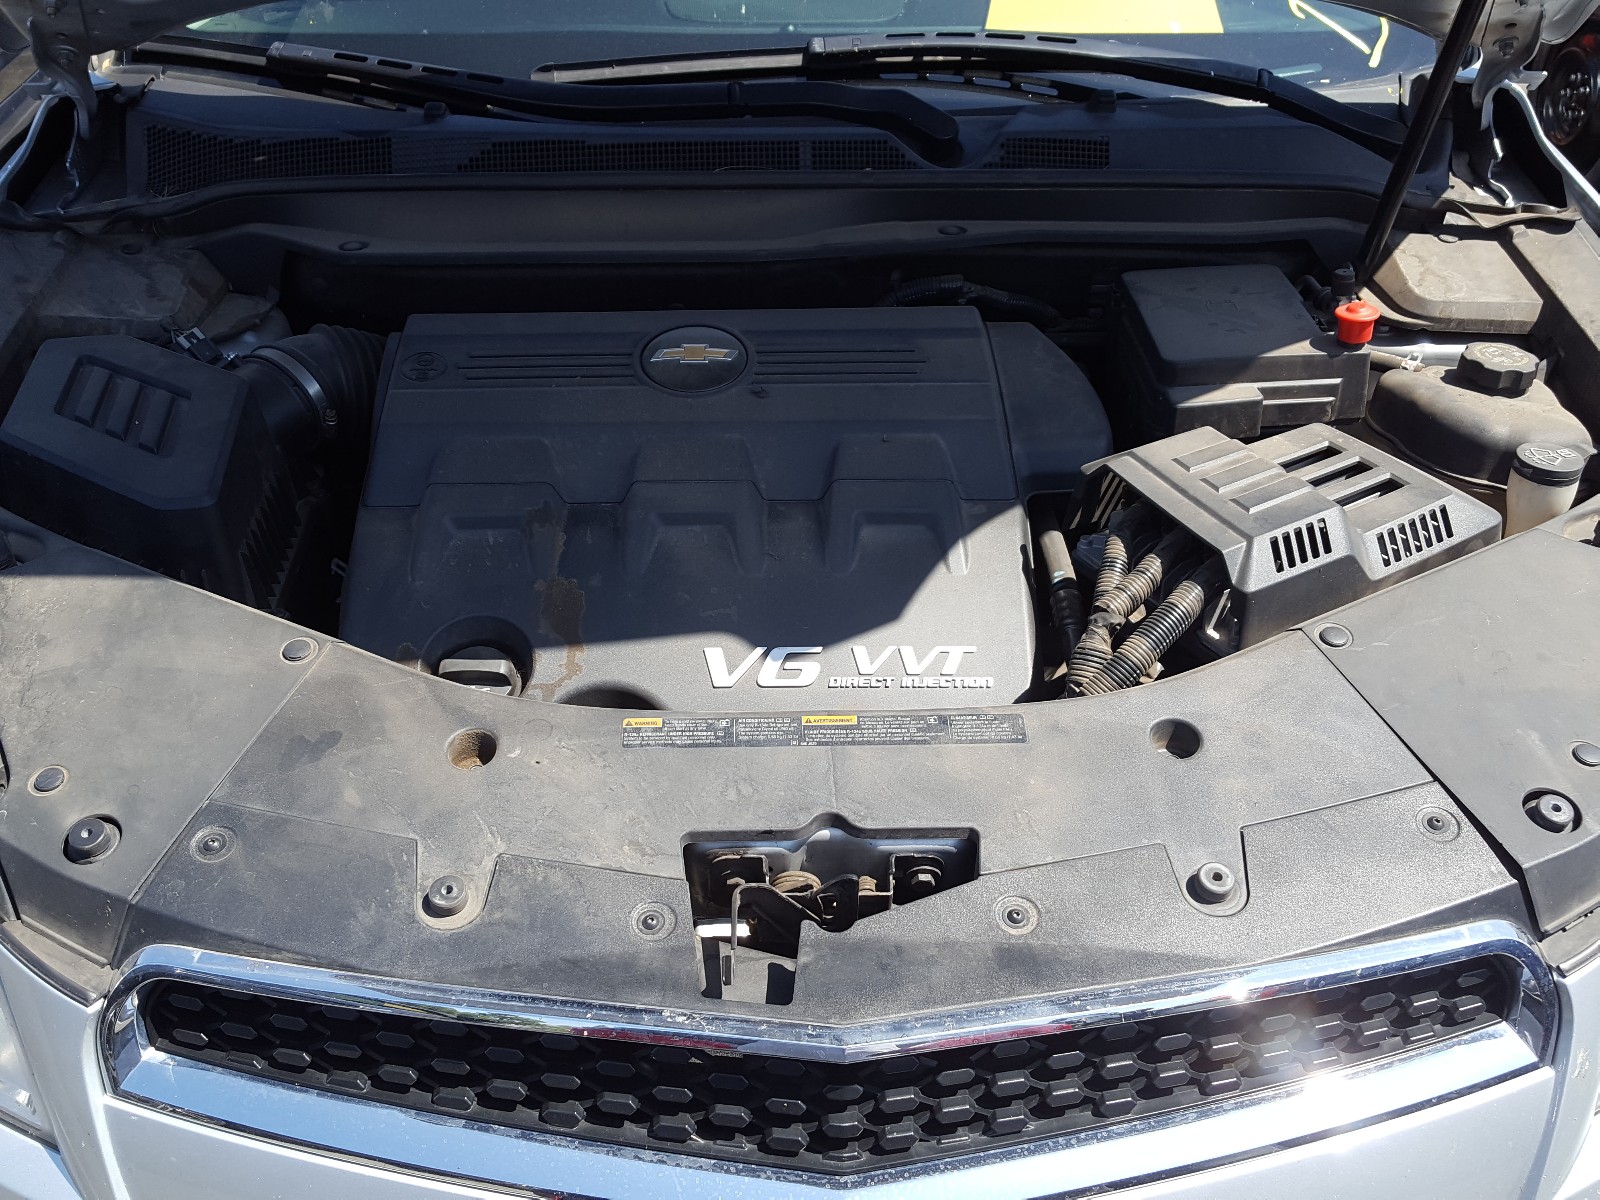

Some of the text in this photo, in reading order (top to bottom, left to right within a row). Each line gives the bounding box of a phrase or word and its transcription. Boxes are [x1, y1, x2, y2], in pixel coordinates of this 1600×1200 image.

[703, 646, 977, 688] V6 VVT
[828, 676, 994, 688] DIRECT INJECTION
